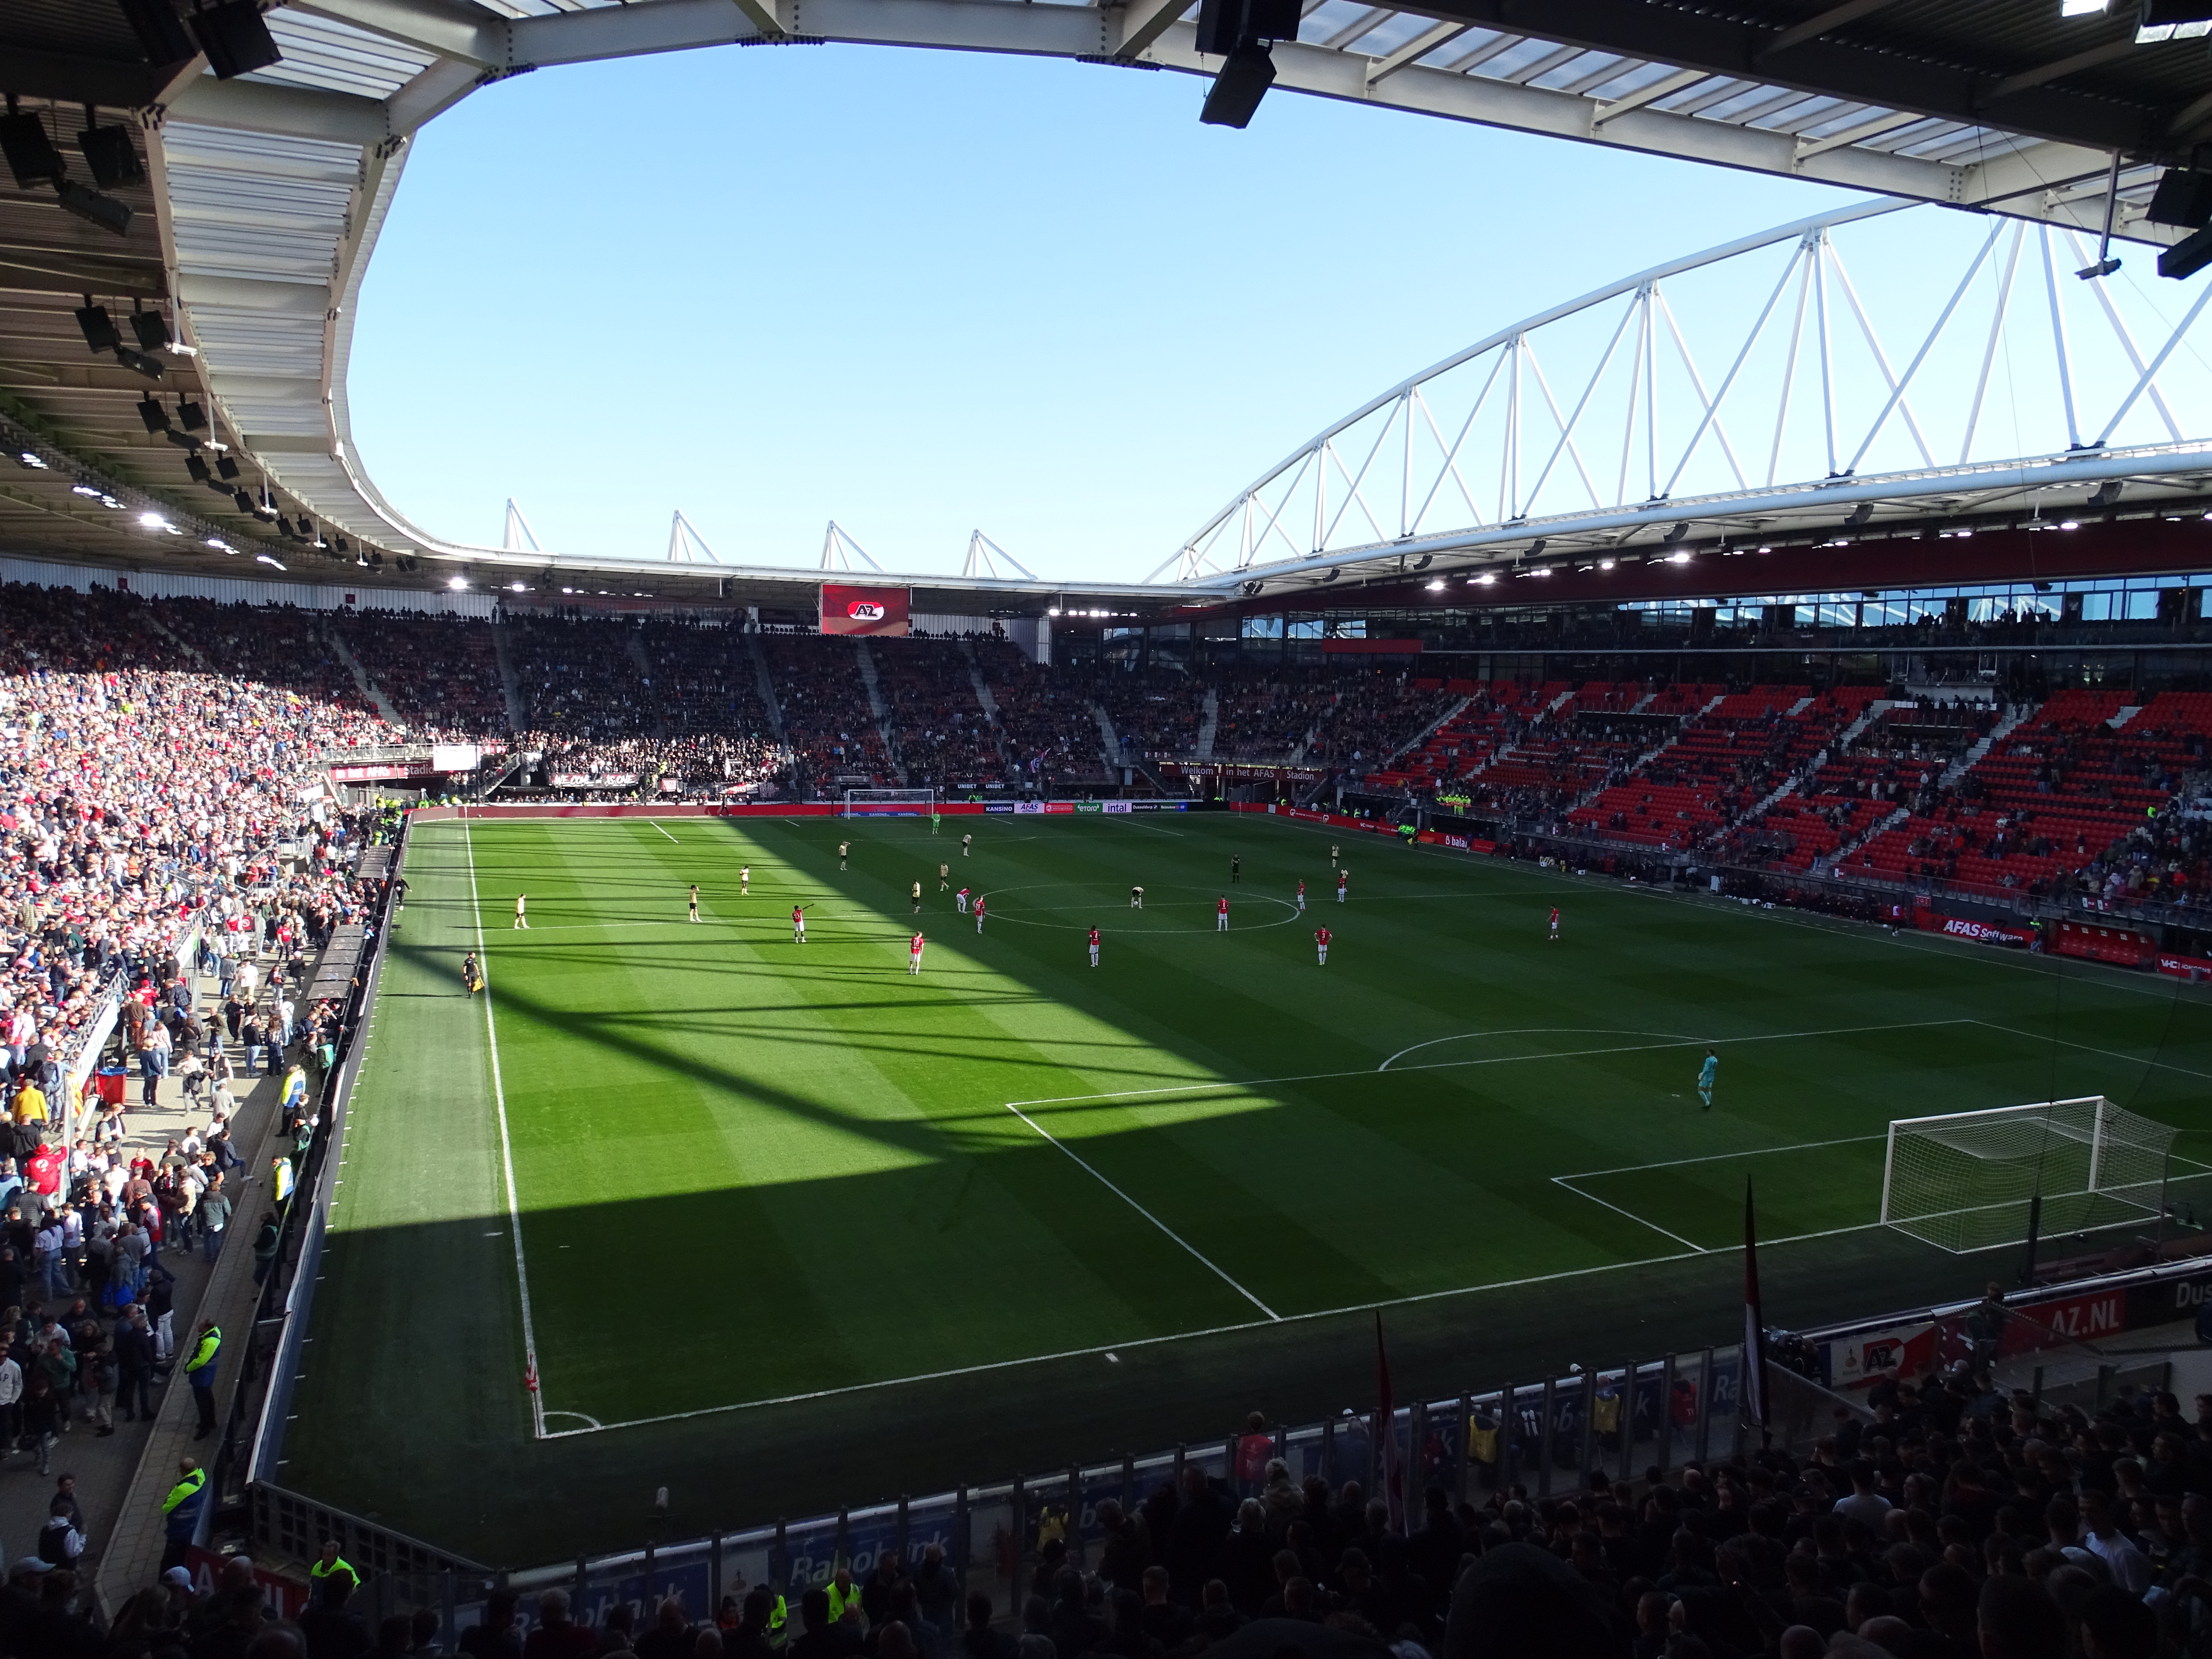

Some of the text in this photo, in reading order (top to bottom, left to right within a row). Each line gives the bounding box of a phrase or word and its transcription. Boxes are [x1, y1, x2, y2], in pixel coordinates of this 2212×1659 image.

[855, 605, 878, 617] AZ
[367, 767, 390, 777] AFAS
[1181, 765, 1314, 780] Welkom in het AFAS Stadion
[1108, 803, 1126, 812] intal
[1943, 920, 1981, 937] AFAS
[2052, 1298, 2119, 1337] AZ.NL
[1863, 1345, 1897, 1373] AZ
